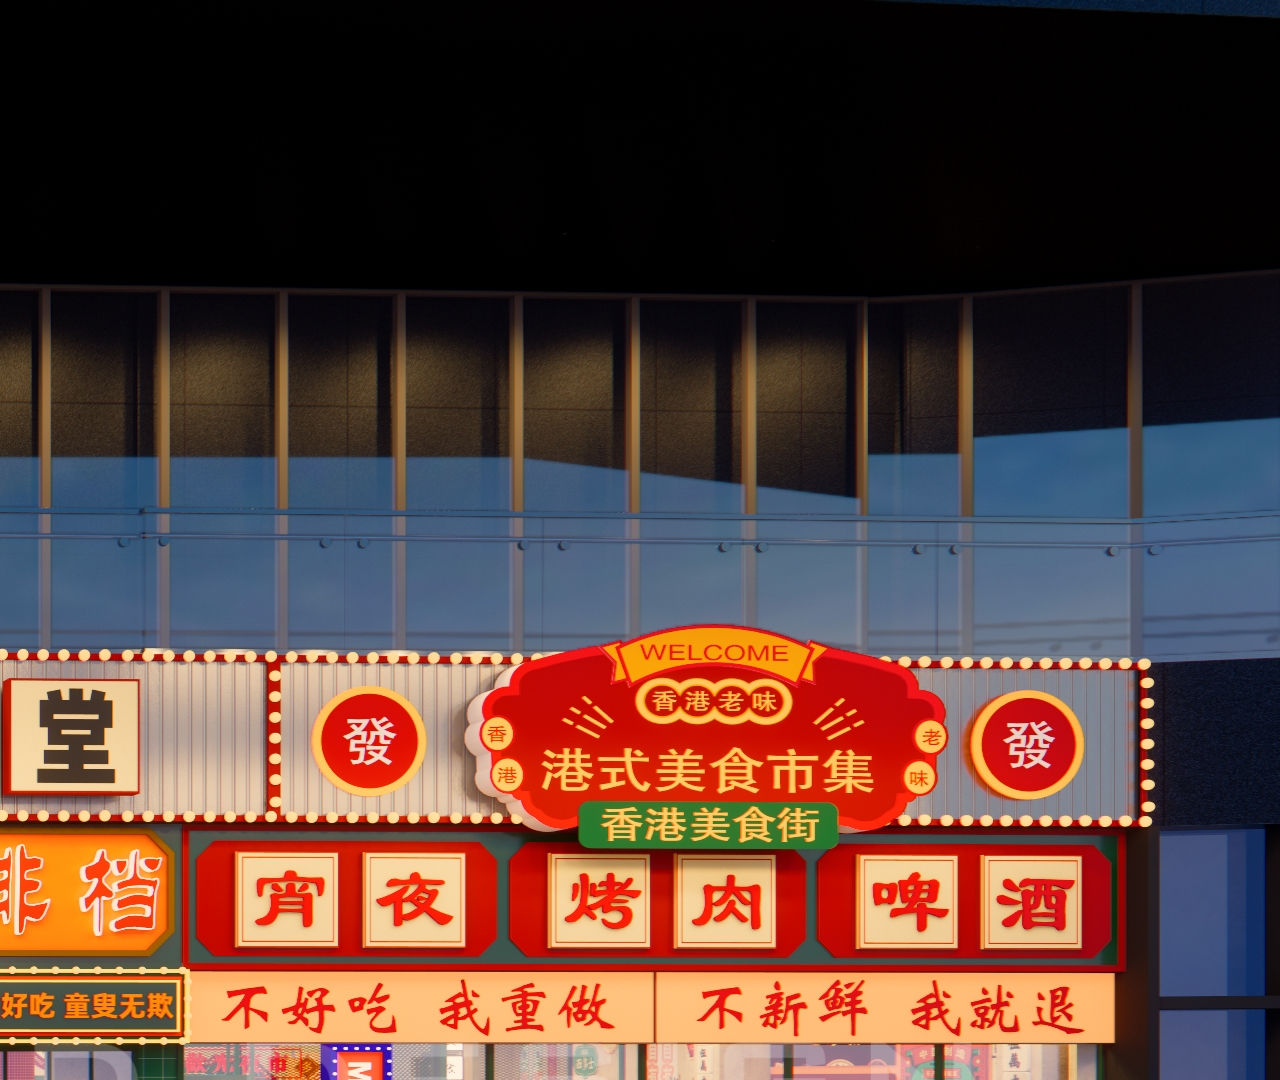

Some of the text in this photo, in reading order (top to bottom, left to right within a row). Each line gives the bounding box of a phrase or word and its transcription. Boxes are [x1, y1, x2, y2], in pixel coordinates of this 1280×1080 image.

[639, 643, 789, 662] WELCOME
[651, 690, 777, 713] 香港老味
[343, 716, 398, 766] 發
[486, 725, 518, 785] 香港
[909, 729, 944, 788] 老味
[1002, 720, 1056, 770] 發
[541, 747, 874, 795] 港式美食市集
[600, 805, 820, 843] 香港美食街
[255, 870, 454, 928] 宵夜
[564, 872, 762, 930] 烤肉
[872, 871, 1076, 933] 啤酒
[63, 992, 174, 1019] 童叟无欺
[222, 979, 616, 1036] 不好吃 我重做
[696, 979, 1085, 1036] 不新鲜 我就退
